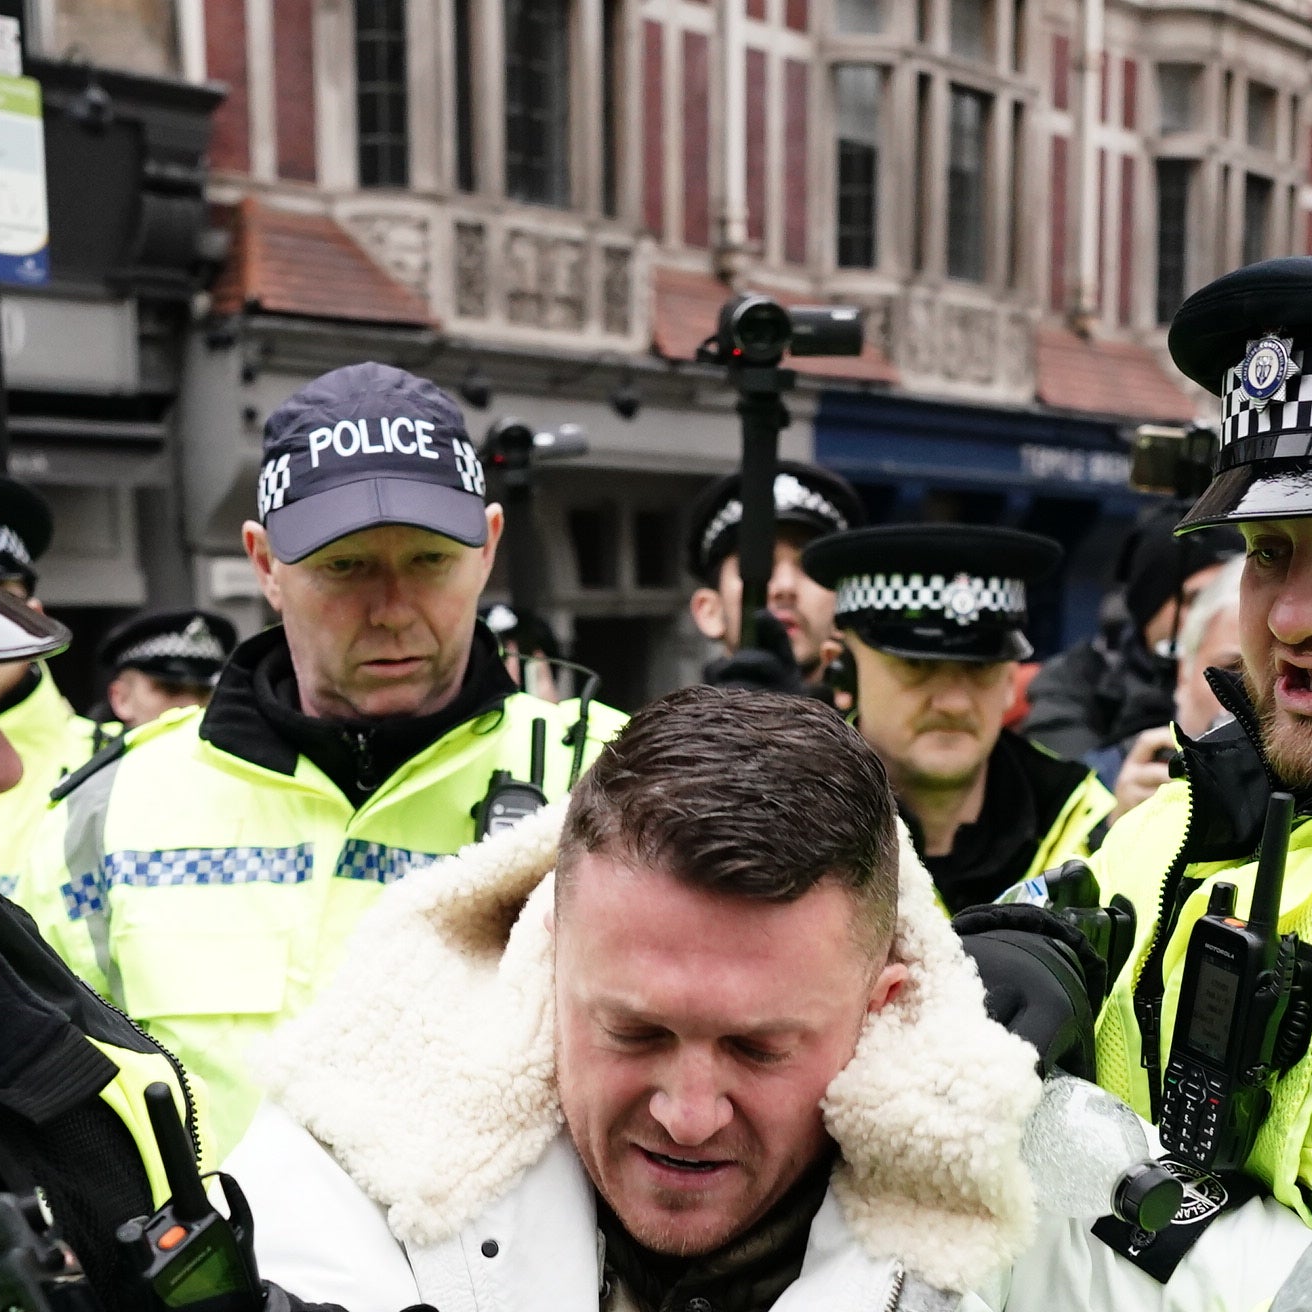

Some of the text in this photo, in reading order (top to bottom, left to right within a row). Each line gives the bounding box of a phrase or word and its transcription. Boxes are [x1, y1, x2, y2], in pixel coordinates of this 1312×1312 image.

[308, 416, 440, 468] POLICE
[1204, 942, 1235, 961] MOTOROLA
[1173, 1199, 1211, 1220] ISLAN
